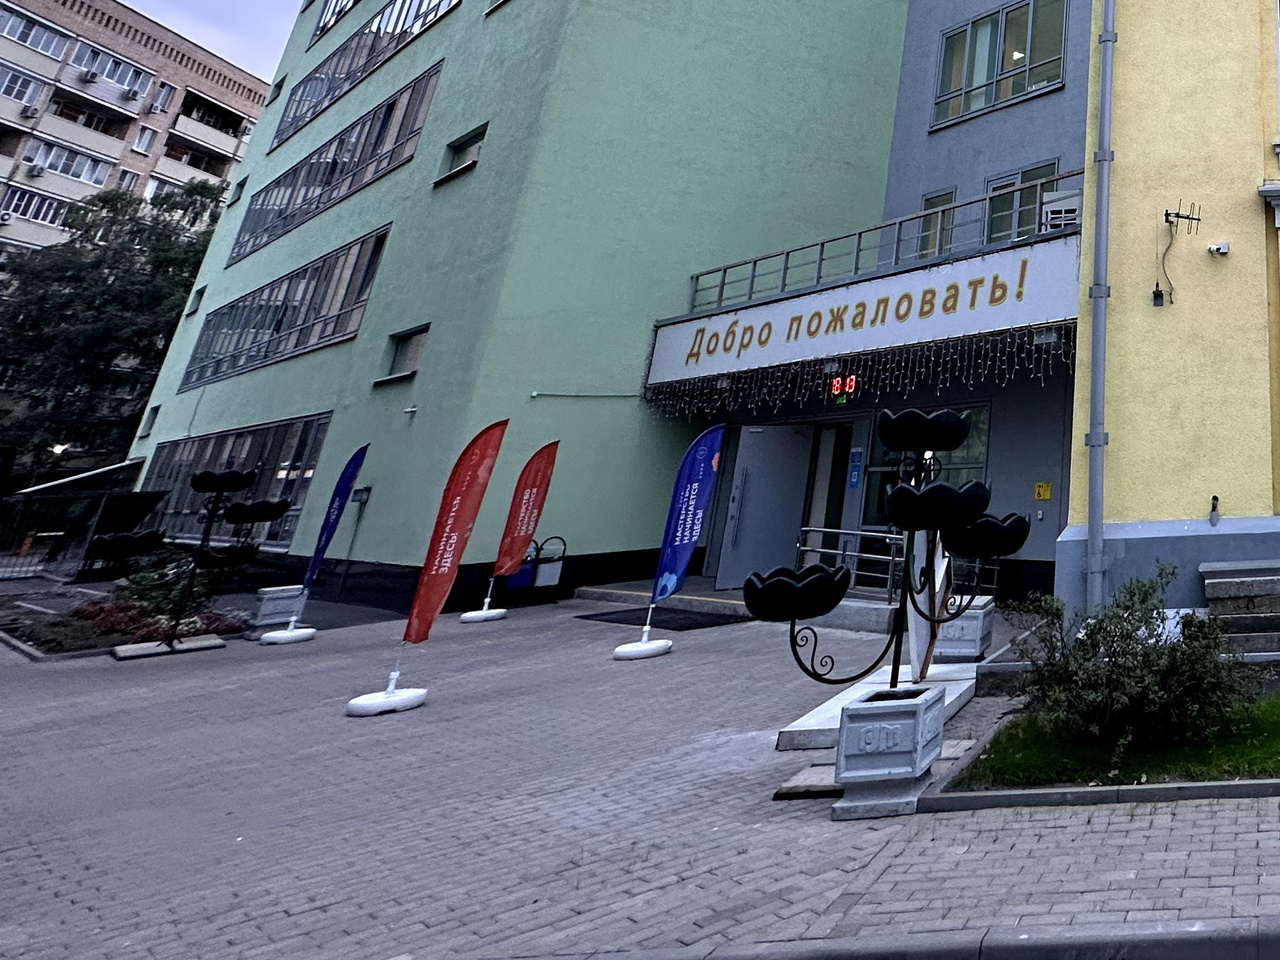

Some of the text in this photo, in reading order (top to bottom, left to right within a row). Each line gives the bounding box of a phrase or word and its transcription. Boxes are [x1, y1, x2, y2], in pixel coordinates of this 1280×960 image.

[685, 257, 1028, 365] Добро пожаловать!
[683, 482, 700, 544] НАЧИНАЕТСЯ
[438, 532, 459, 575] ЗДЕСЬ!
